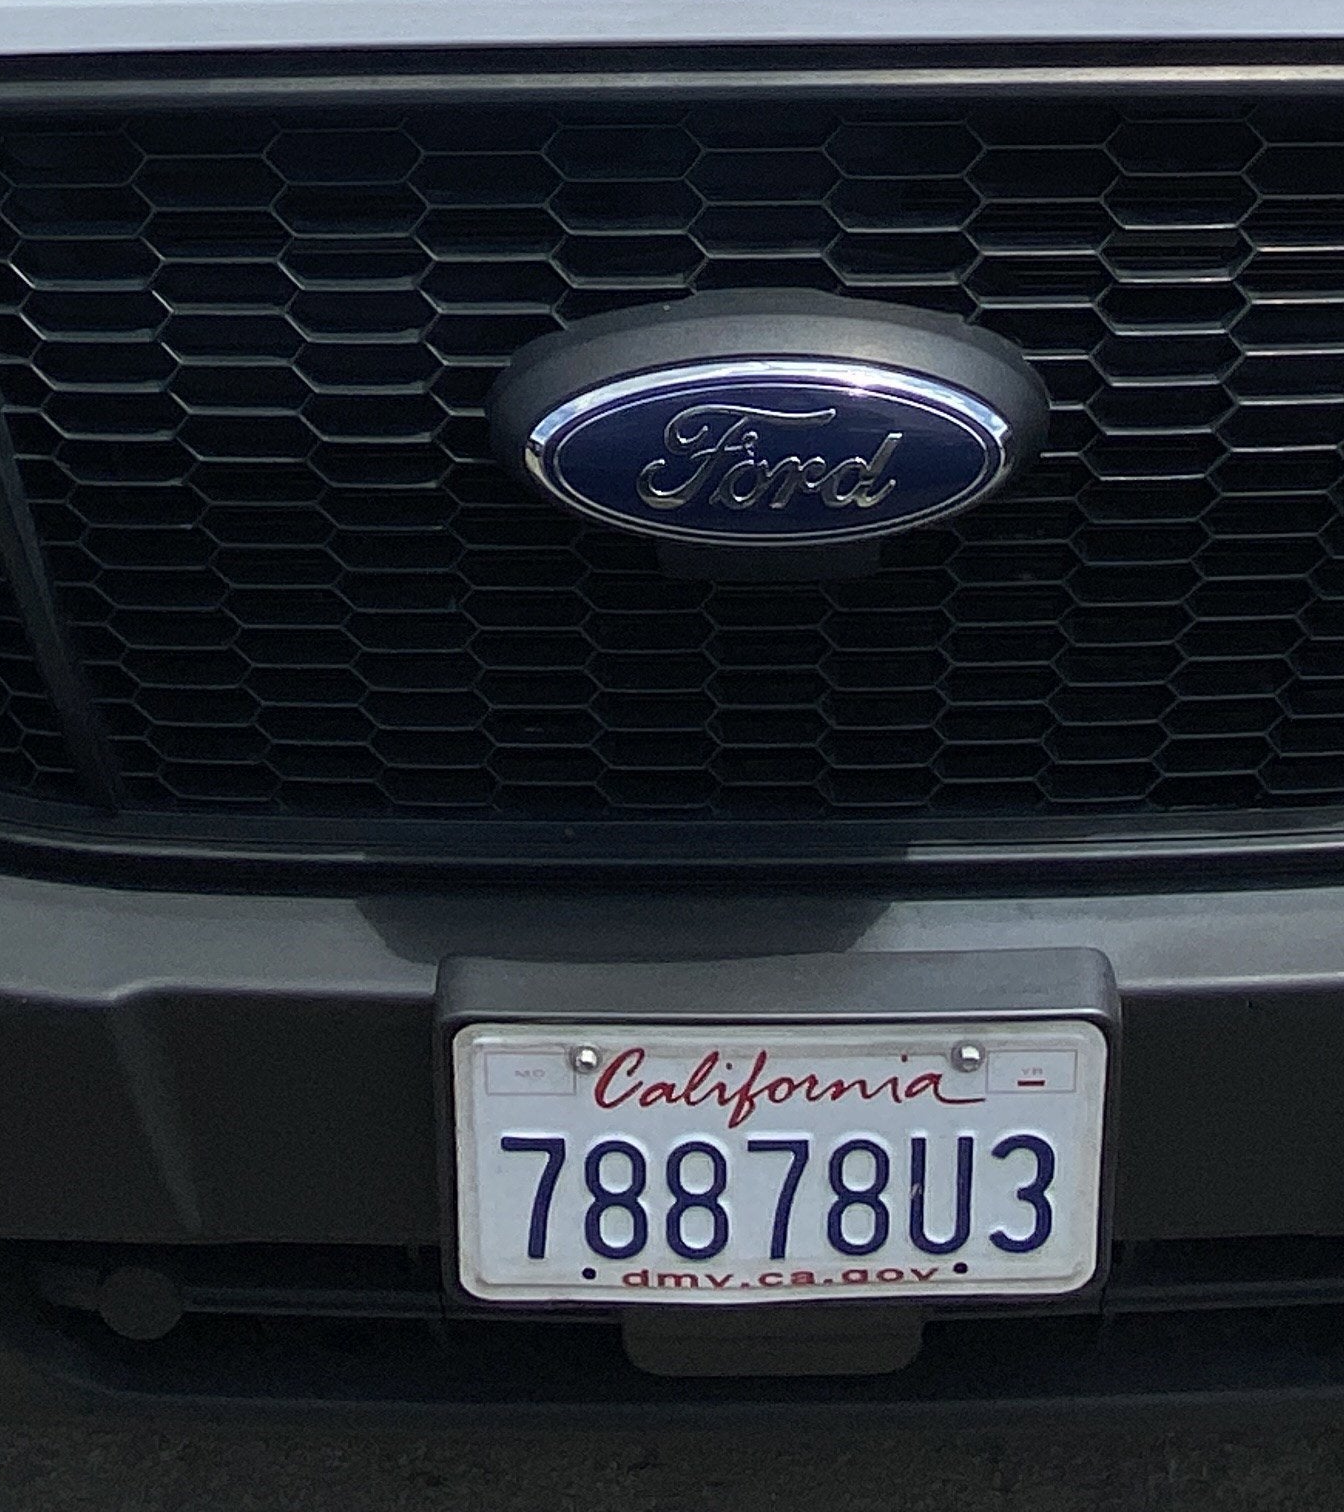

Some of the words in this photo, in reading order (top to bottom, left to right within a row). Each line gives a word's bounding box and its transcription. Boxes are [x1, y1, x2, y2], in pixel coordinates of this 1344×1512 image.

[636, 402, 904, 510] Ford
[594, 1047, 986, 1129] California
[500, 1133, 1057, 1261] 78878U3
[621, 1267, 939, 1289] dmv.ca.gov
